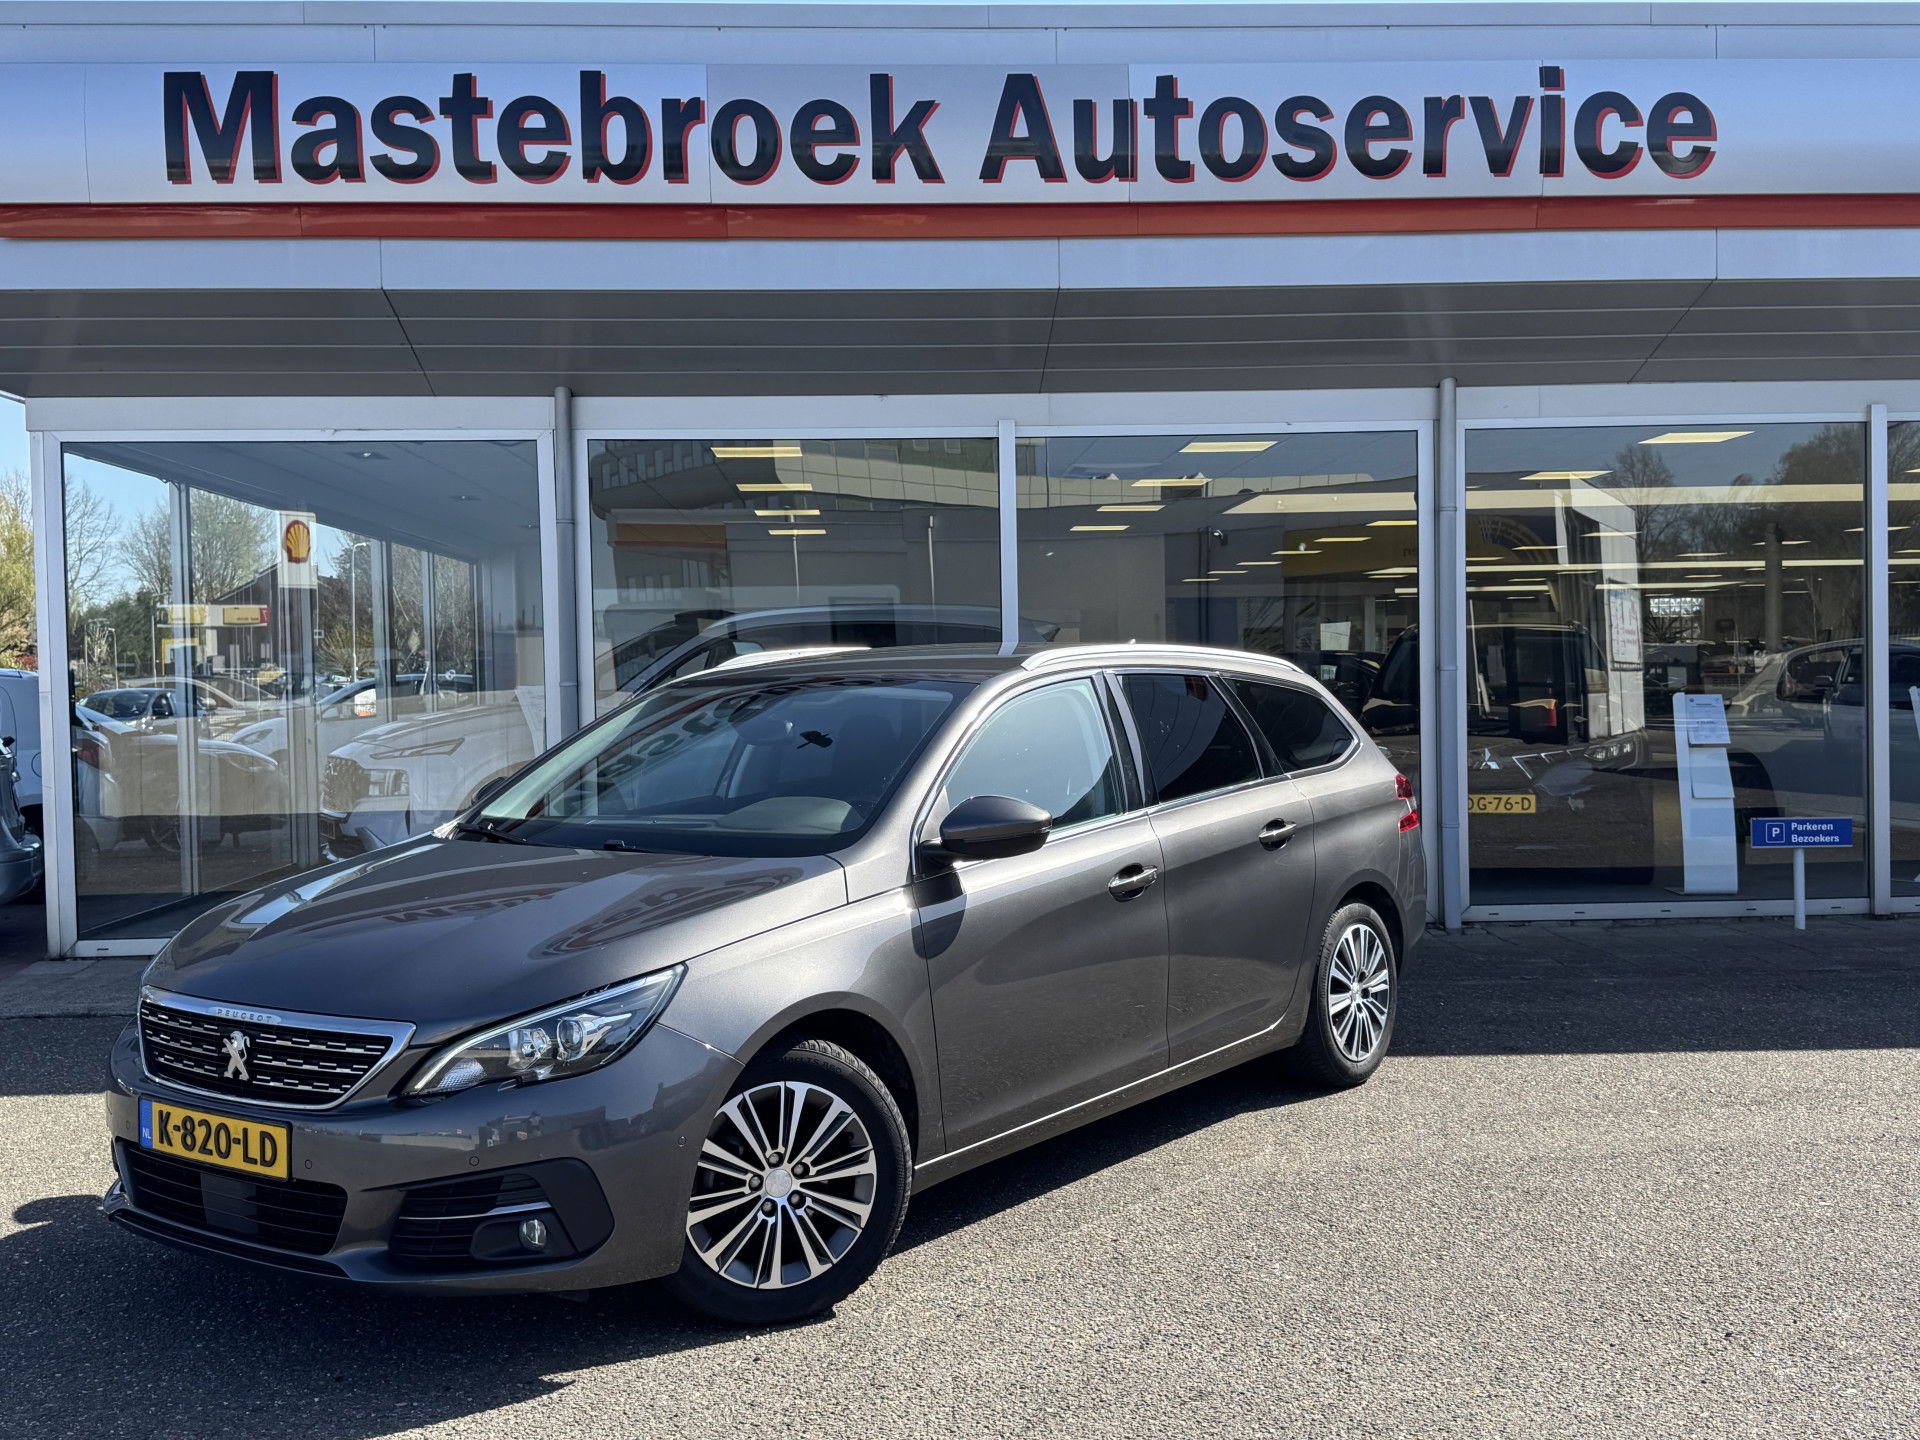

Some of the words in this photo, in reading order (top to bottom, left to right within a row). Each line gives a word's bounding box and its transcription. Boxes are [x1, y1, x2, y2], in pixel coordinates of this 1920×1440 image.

[164, 71, 944, 187] Mastebroek
[980, 66, 1717, 184] Autoservice
[1772, 827, 1780, 838] P
[1791, 822, 1833, 831] Parkeren
[1791, 834, 1839, 842] Bezoekers
[217, 1008, 273, 1022] PEUGEOT
[142, 1127, 152, 1139] NL
[158, 1110, 278, 1167] K-820-LD
